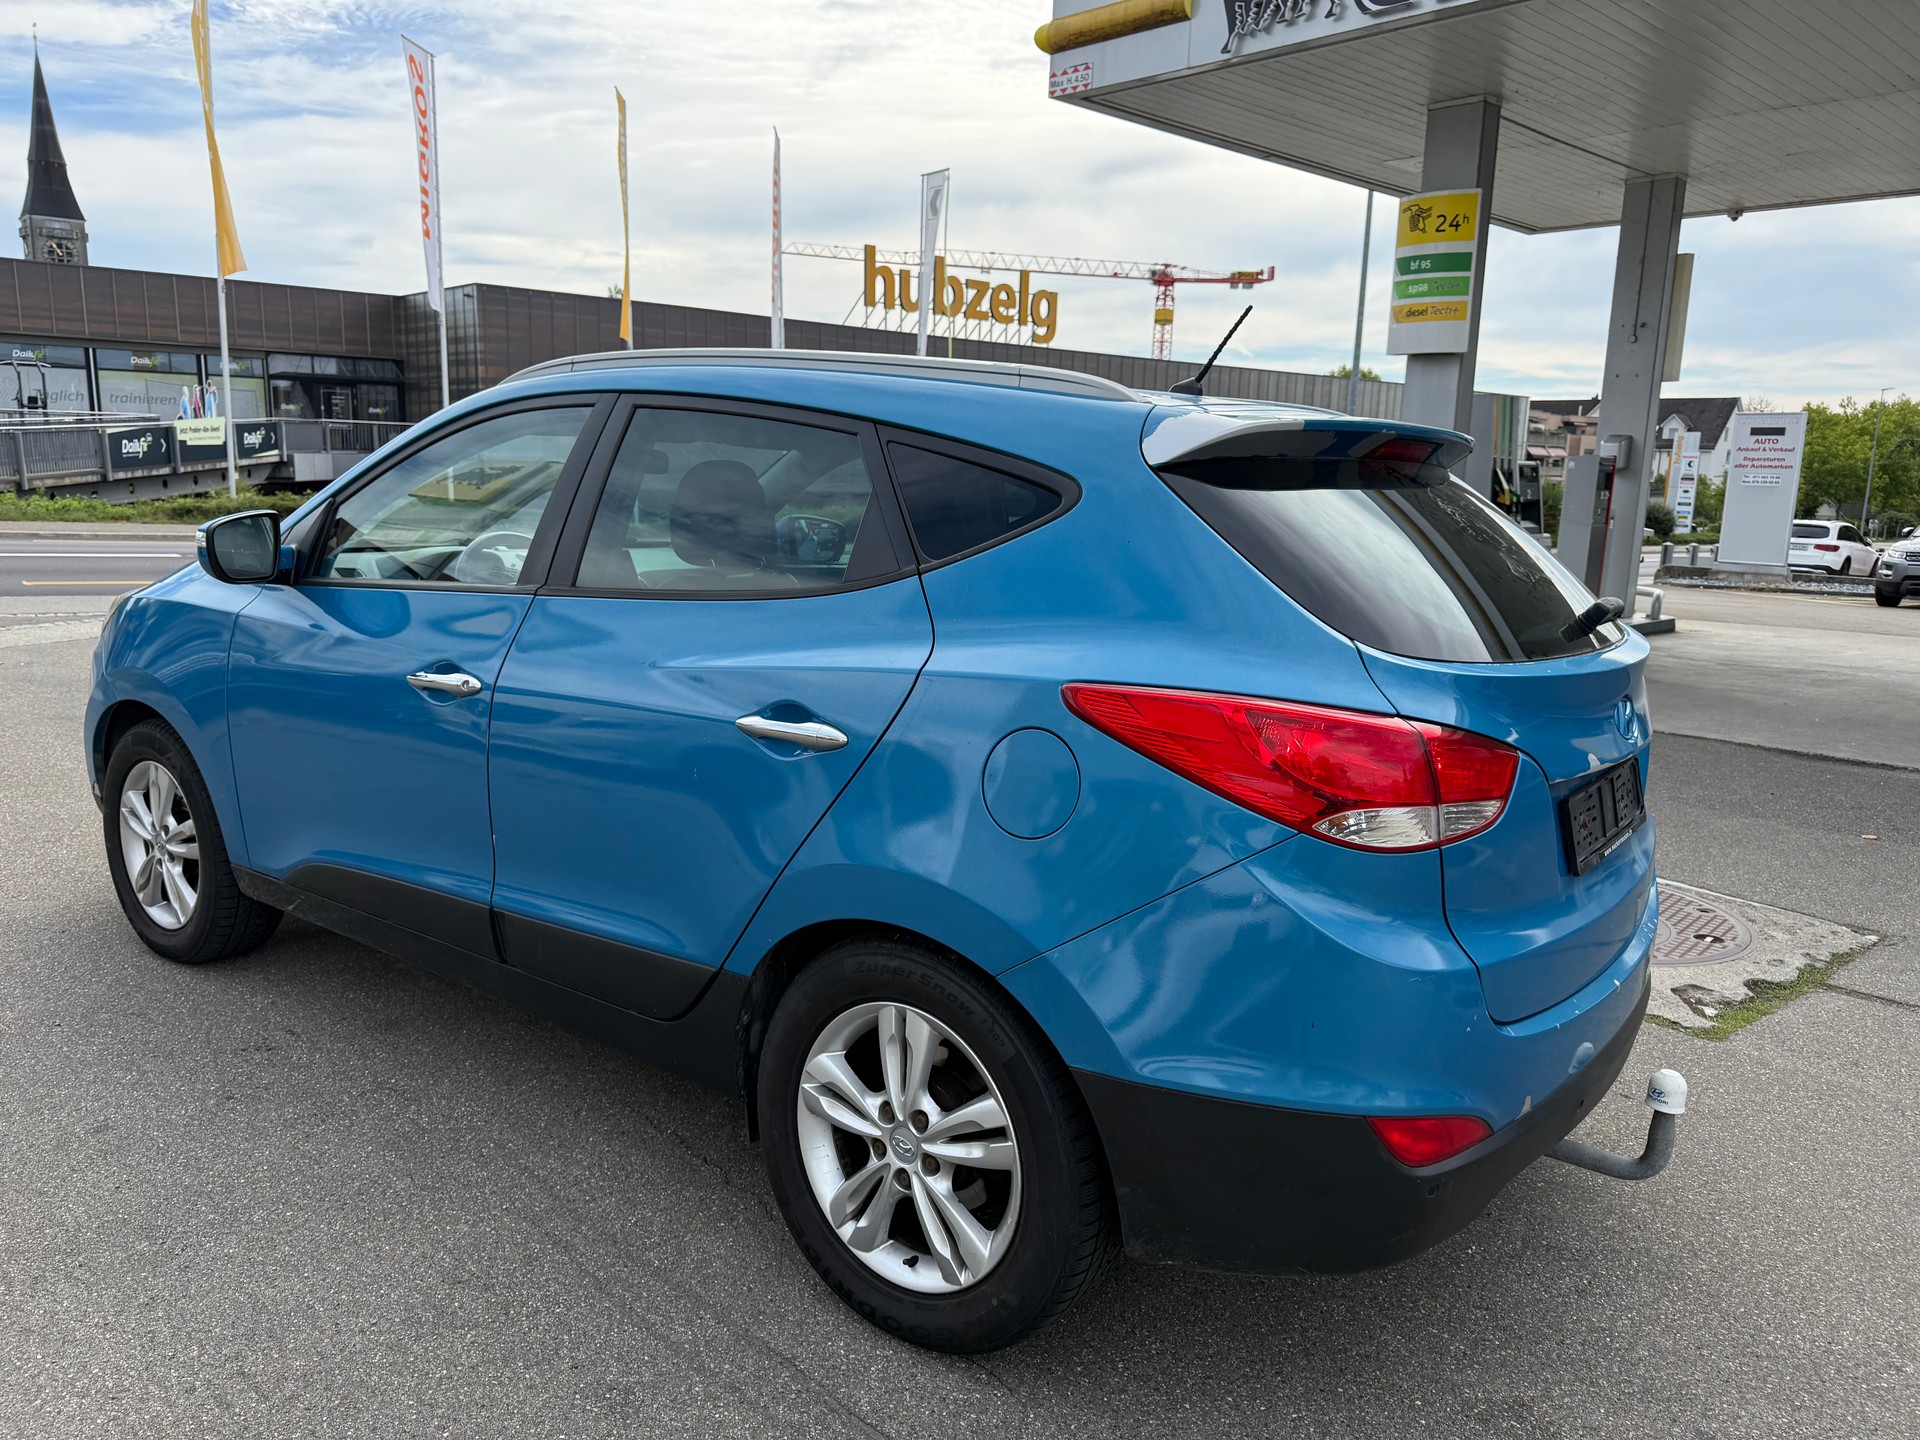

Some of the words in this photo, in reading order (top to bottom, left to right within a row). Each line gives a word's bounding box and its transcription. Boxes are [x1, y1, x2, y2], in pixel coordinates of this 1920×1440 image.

[864, 244, 1058, 344] hubzelg
[1405, 307, 1428, 318] diesel
[1743, 456, 1786, 464] Reparaturen
[1750, 463, 1794, 471] Automarken
